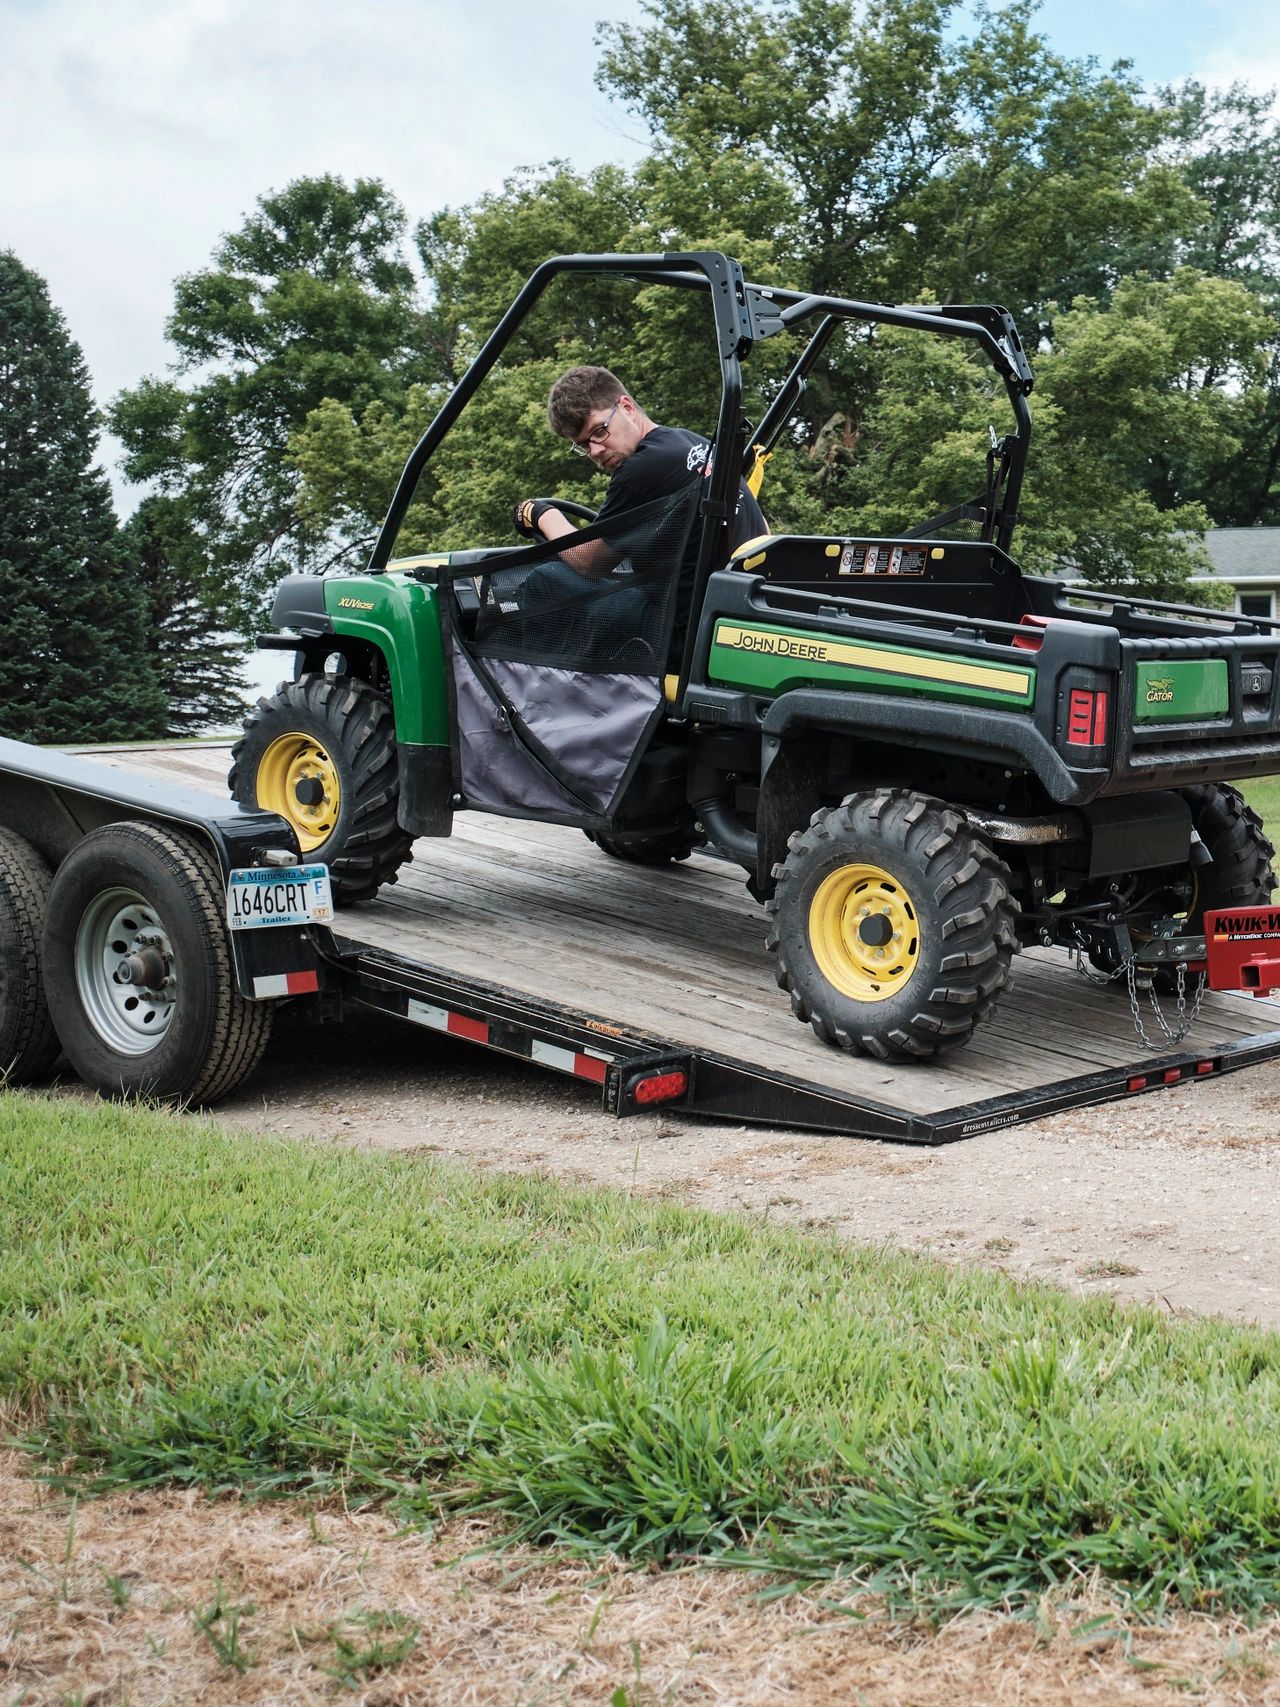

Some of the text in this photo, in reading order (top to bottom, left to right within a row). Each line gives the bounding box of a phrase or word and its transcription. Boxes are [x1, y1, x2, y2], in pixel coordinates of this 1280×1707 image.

[733, 632, 828, 659] JOHN DEERE
[1146, 690, 1173, 702] GATOR
[233, 882, 307, 917] 1646CRT
[260, 916, 291, 924] Trailer
